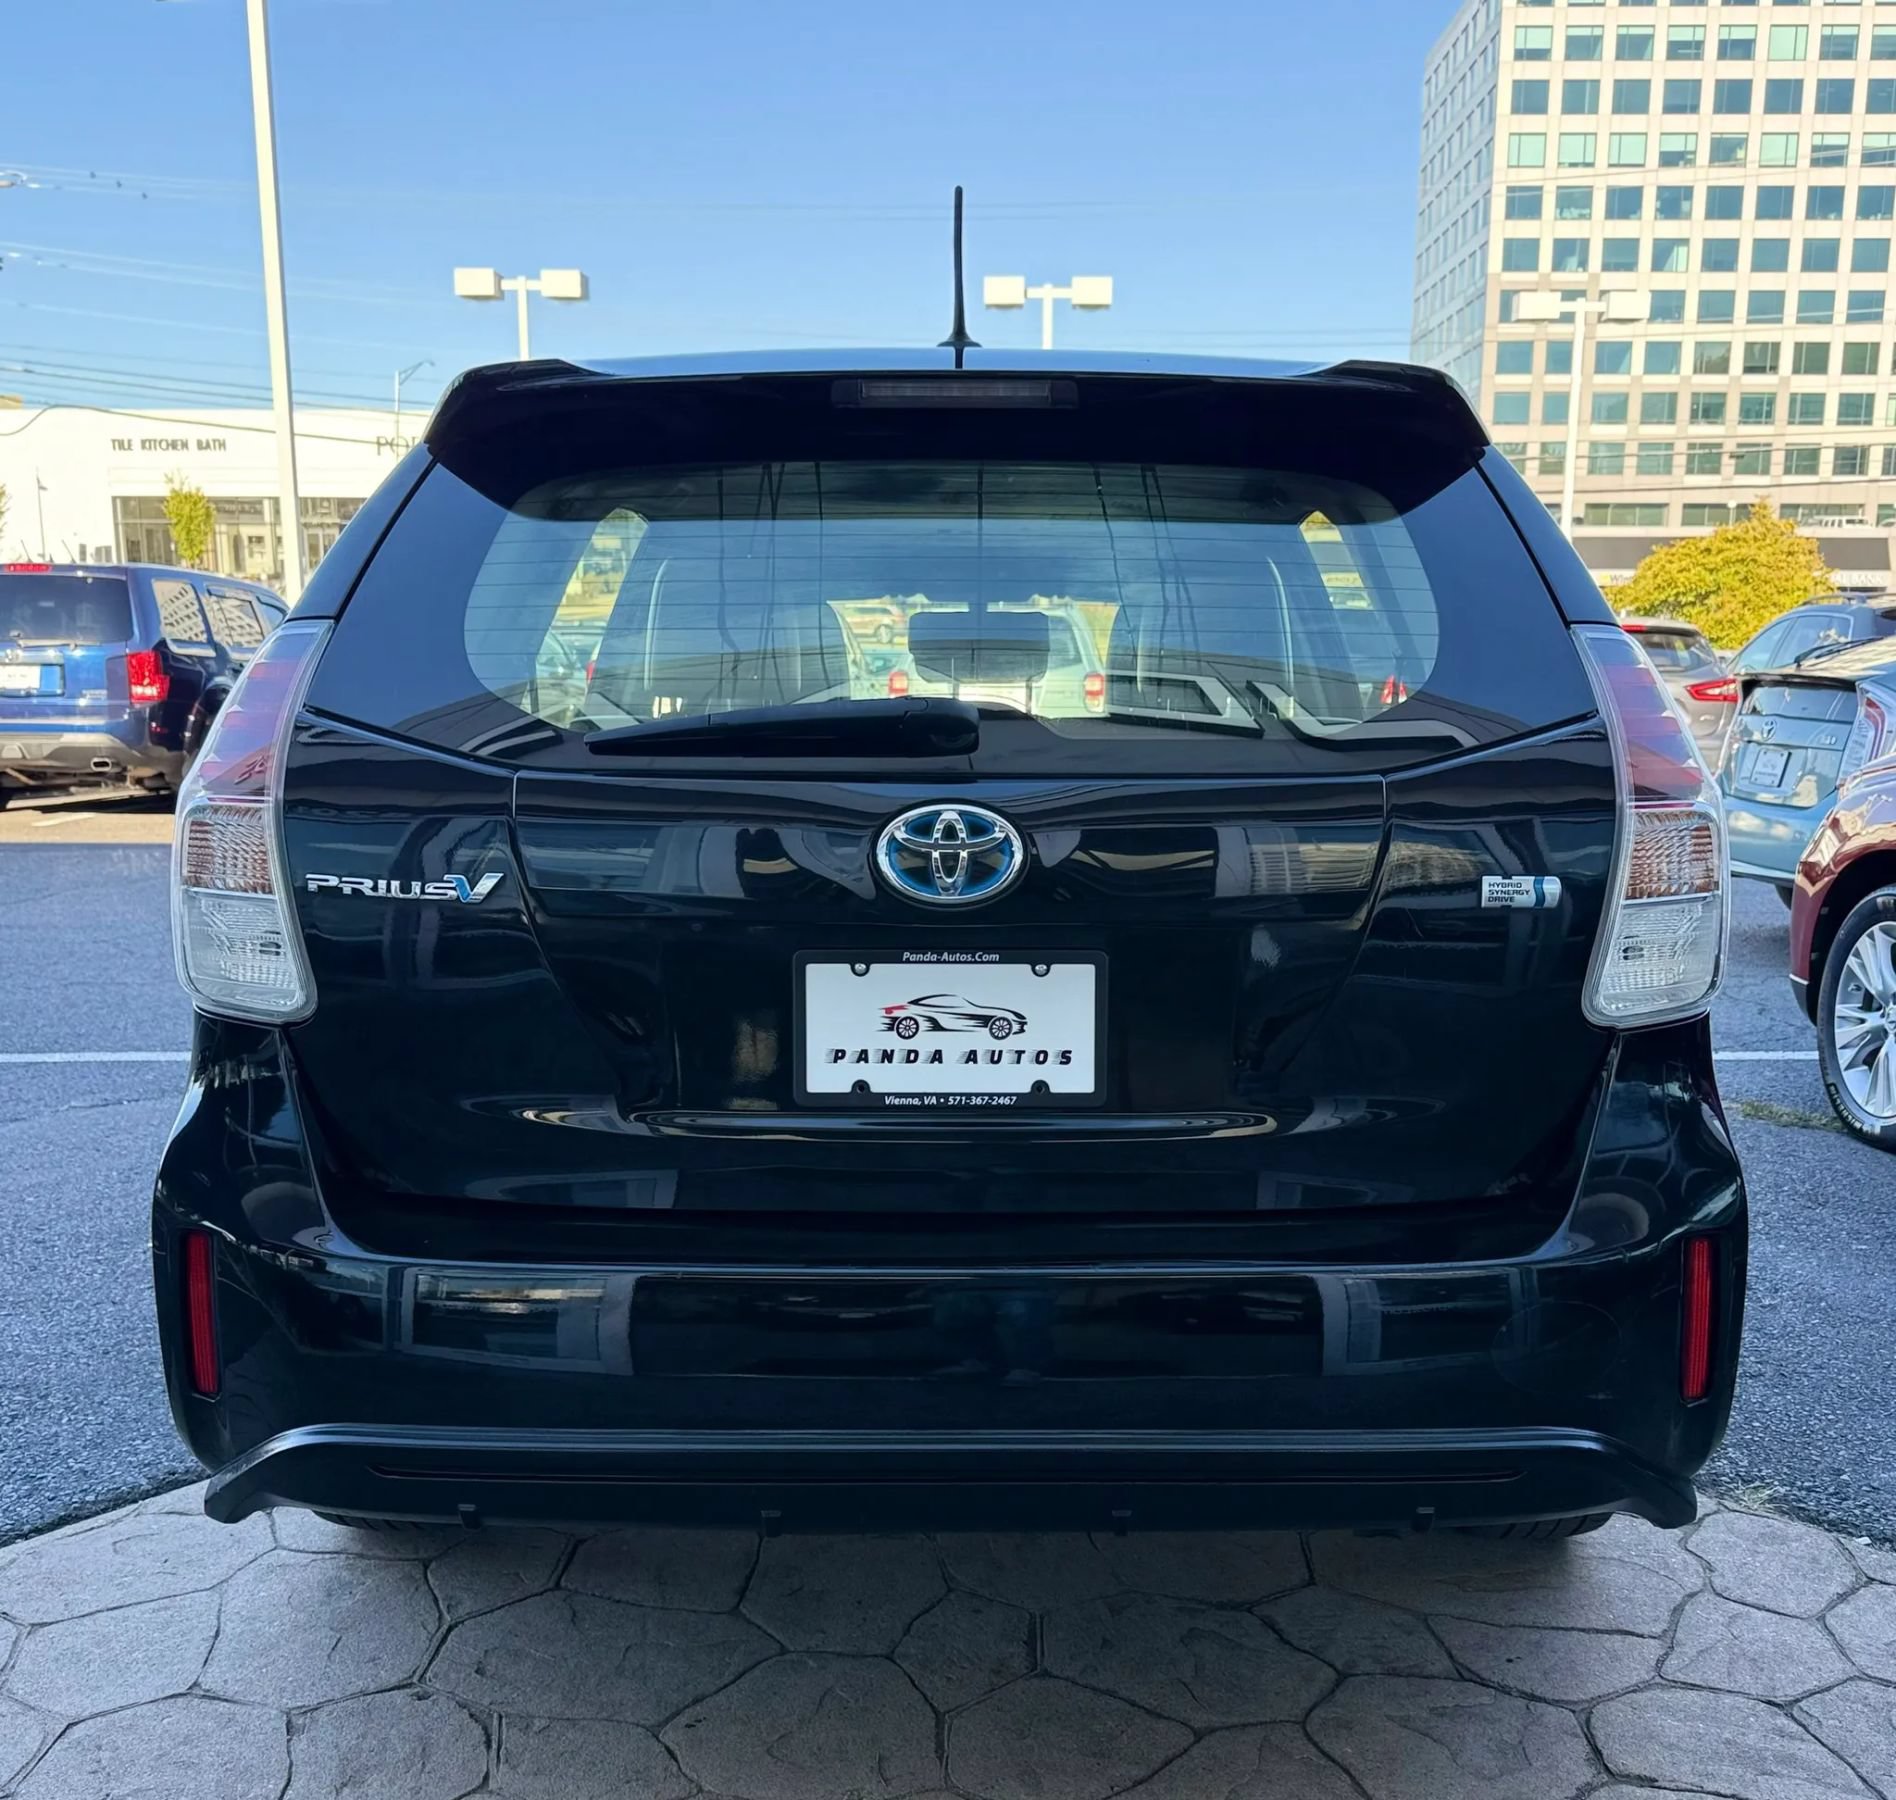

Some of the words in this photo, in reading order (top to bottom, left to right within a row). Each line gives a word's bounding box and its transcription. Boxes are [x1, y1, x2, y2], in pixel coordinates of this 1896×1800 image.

[111, 438, 133, 451] TILE
[140, 438, 189, 451] KITCHEN
[196, 438, 227, 452] BATH
[902, 951, 1000, 963] Panda-Autos.Com
[828, 1048, 943, 1065] PANDA
[960, 1048, 1073, 1066] AUTOS
[884, 1095, 922, 1107] Vienna,
[923, 1095, 937, 1105] VA
[947, 1095, 1017, 1106] 571-367-2467
